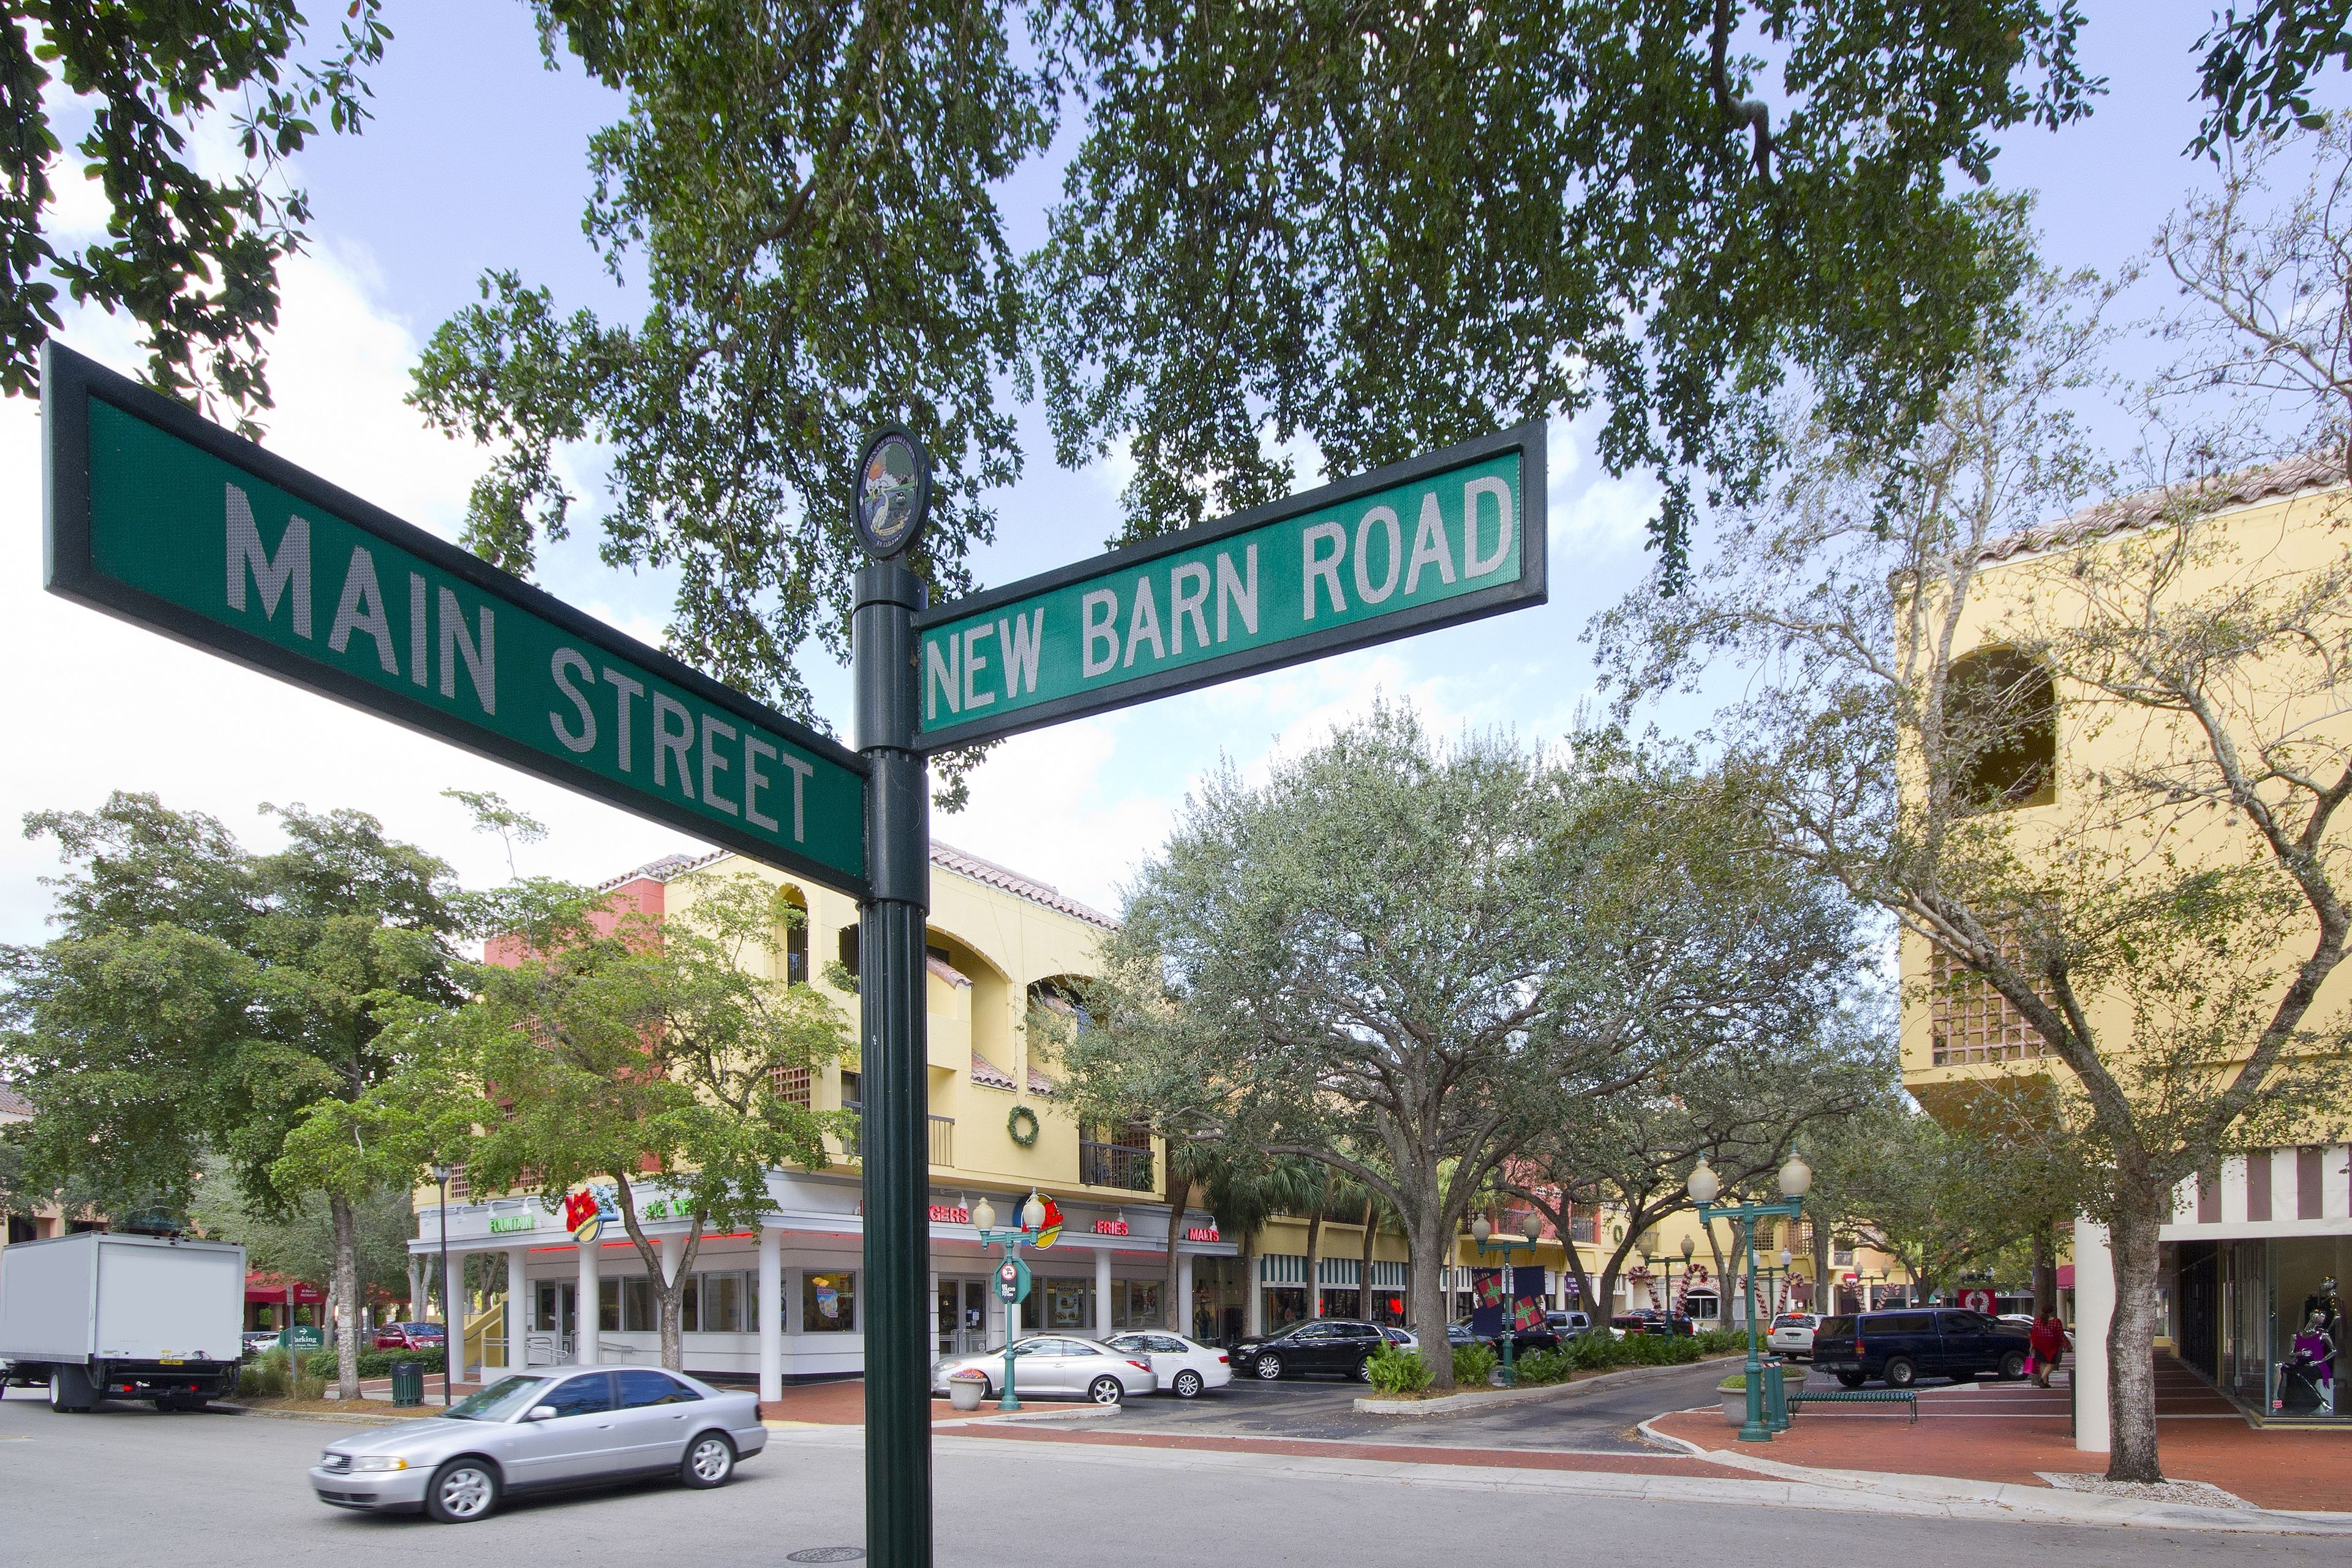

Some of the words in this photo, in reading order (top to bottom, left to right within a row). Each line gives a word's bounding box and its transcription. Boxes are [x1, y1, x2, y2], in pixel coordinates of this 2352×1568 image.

[927, 607, 1044, 720] NEW
[1082, 543, 1259, 678] BARN
[1303, 476, 1512, 620] ROAD
[225, 481, 496, 716] MAIN
[549, 647, 814, 844] STREET
[490, 1215, 534, 1232] FOUNTAIN
[1096, 1220, 1128, 1236] FRIES
[1188, 1228, 1219, 1242] MALTS
